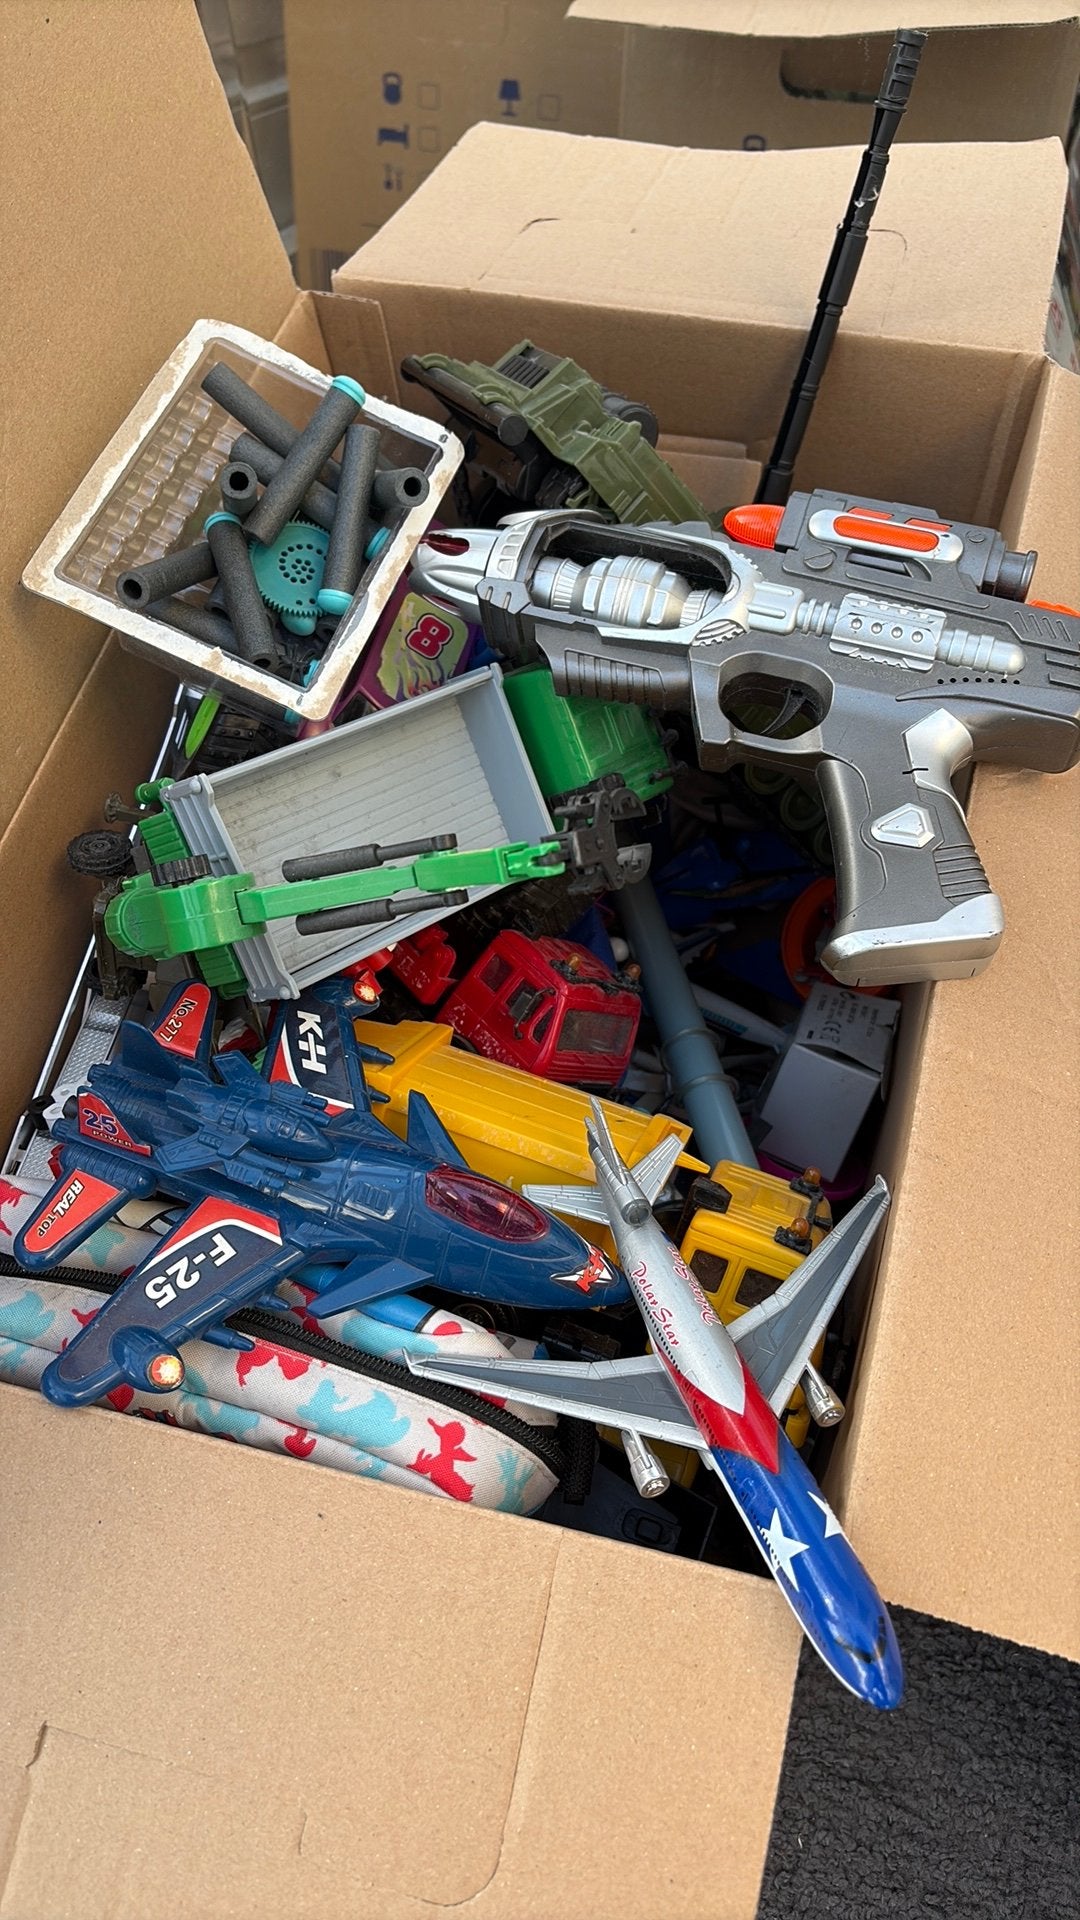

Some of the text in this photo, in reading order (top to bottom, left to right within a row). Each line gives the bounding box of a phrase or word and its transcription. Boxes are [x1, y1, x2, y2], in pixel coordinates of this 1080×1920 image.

[405, 613, 454, 660] 8
[82, 1108, 119, 1136] 25
[92, 1130, 132, 1148] POWER
[36, 1178, 85, 1238] REAL TOP
[144, 1232, 238, 1310] F-25
[631, 1260, 680, 1347] Polar Star
